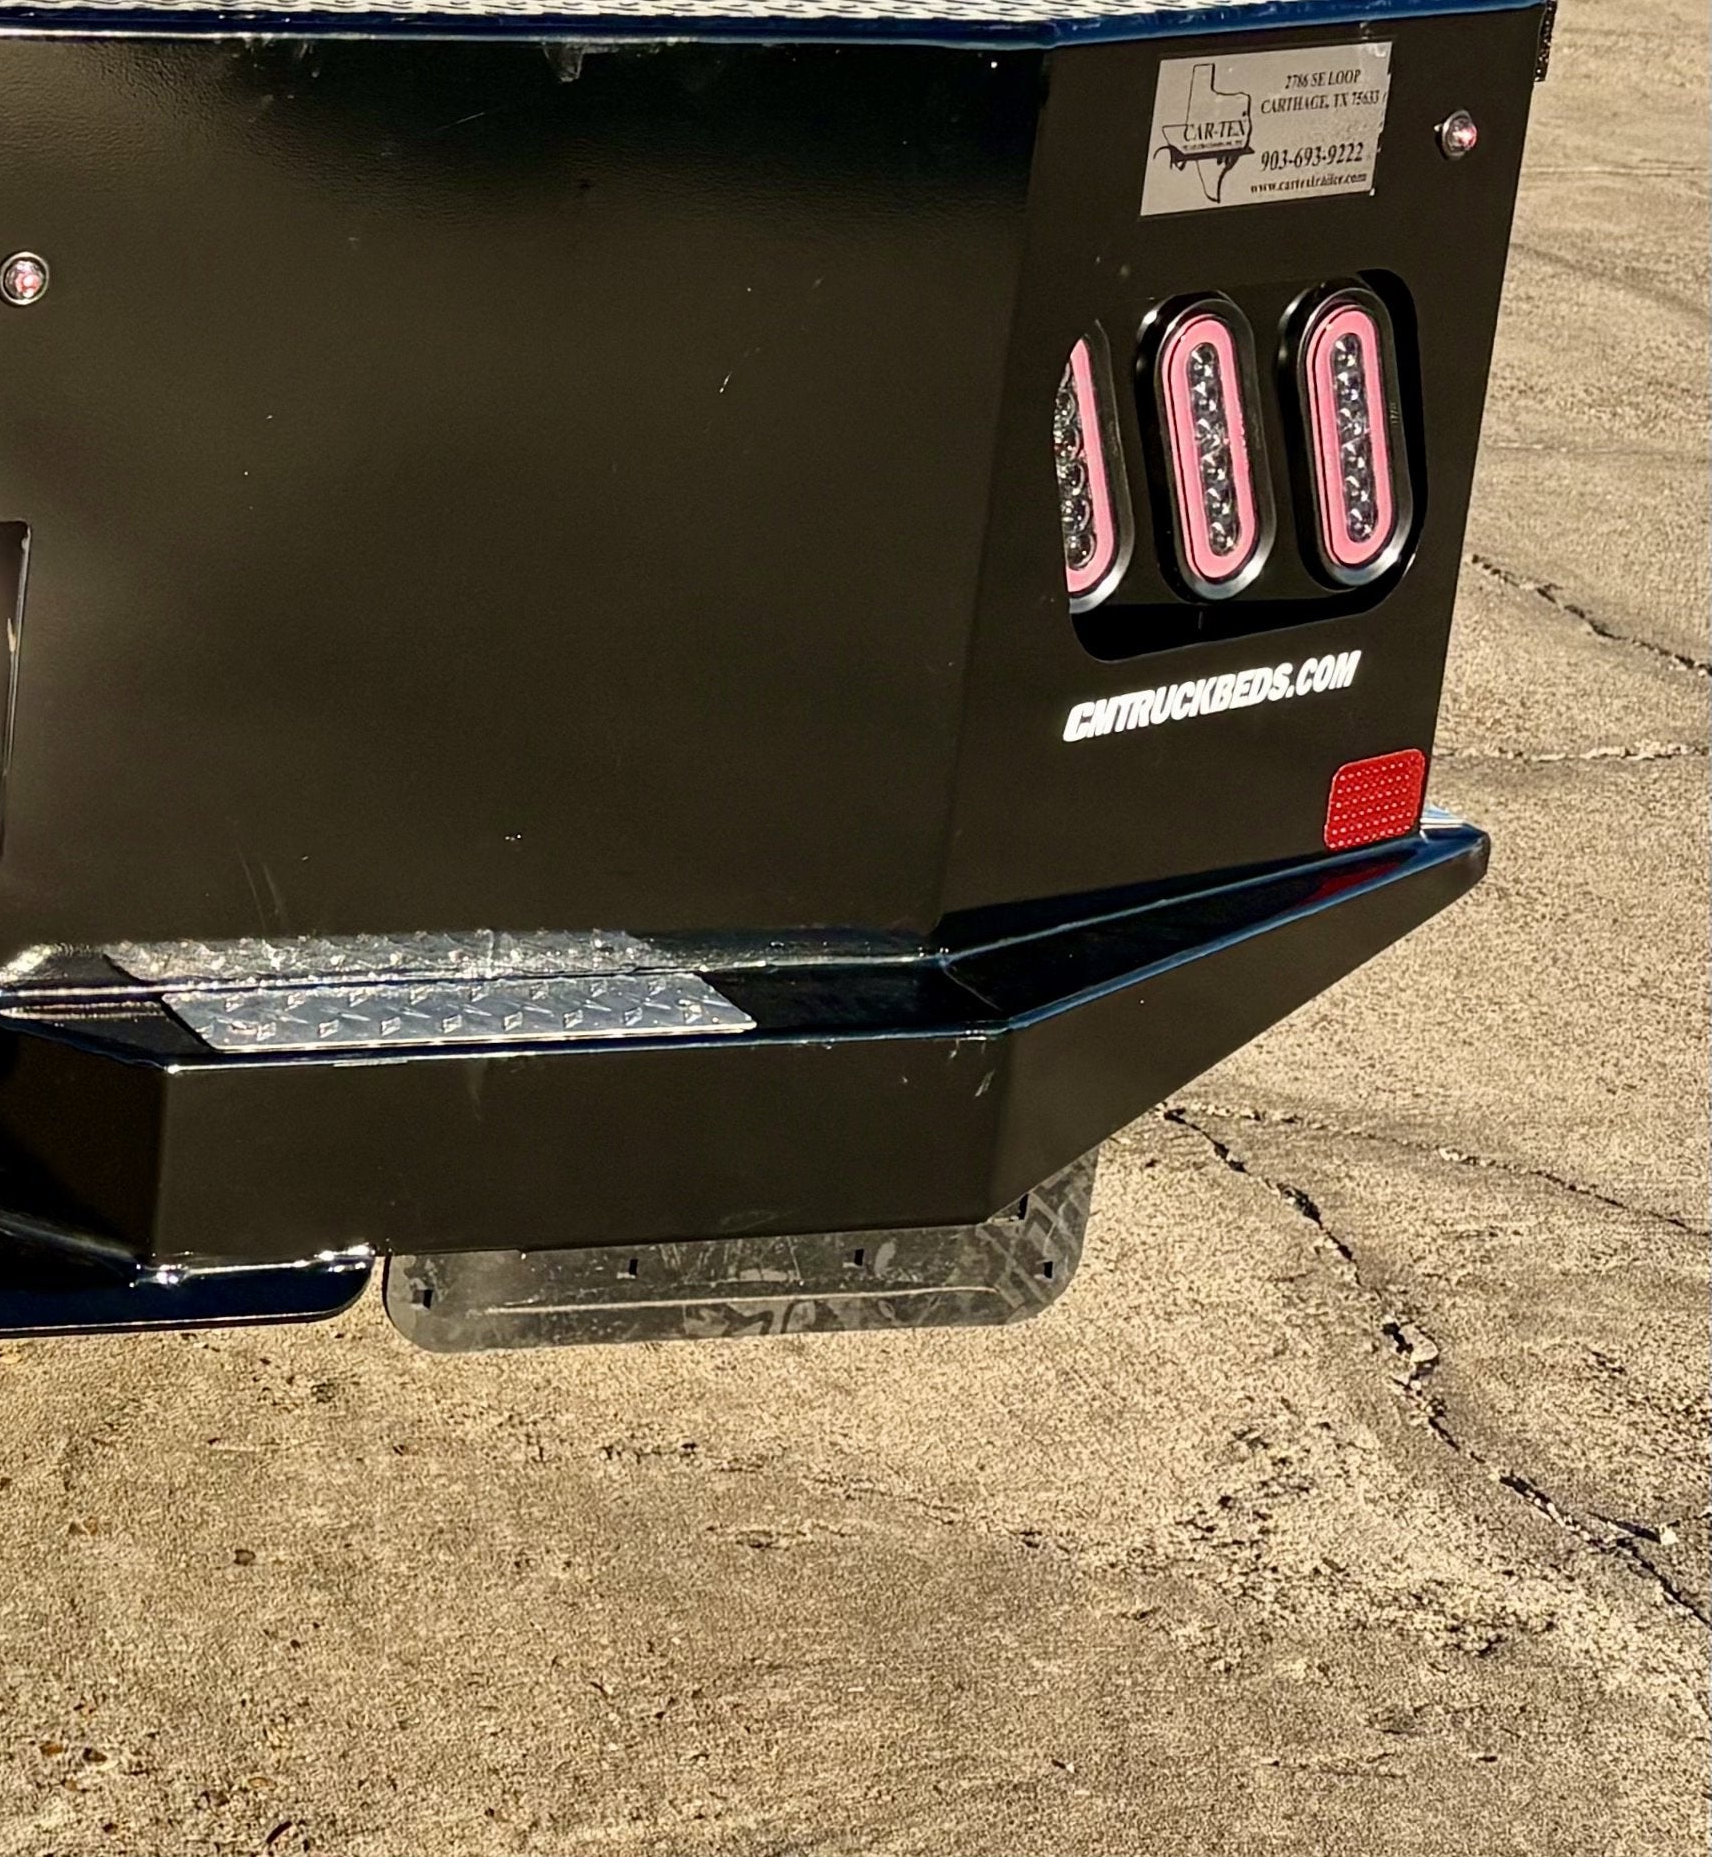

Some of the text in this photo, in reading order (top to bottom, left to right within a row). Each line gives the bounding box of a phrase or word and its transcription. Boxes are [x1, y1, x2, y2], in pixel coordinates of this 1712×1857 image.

[1311, 72, 1327, 87] SE
[1328, 69, 1362, 86] LOOP
[1261, 142, 1365, 172] 903-693-9222
[1063, 650, 1362, 742] CMTRUCKBEDS.COM
